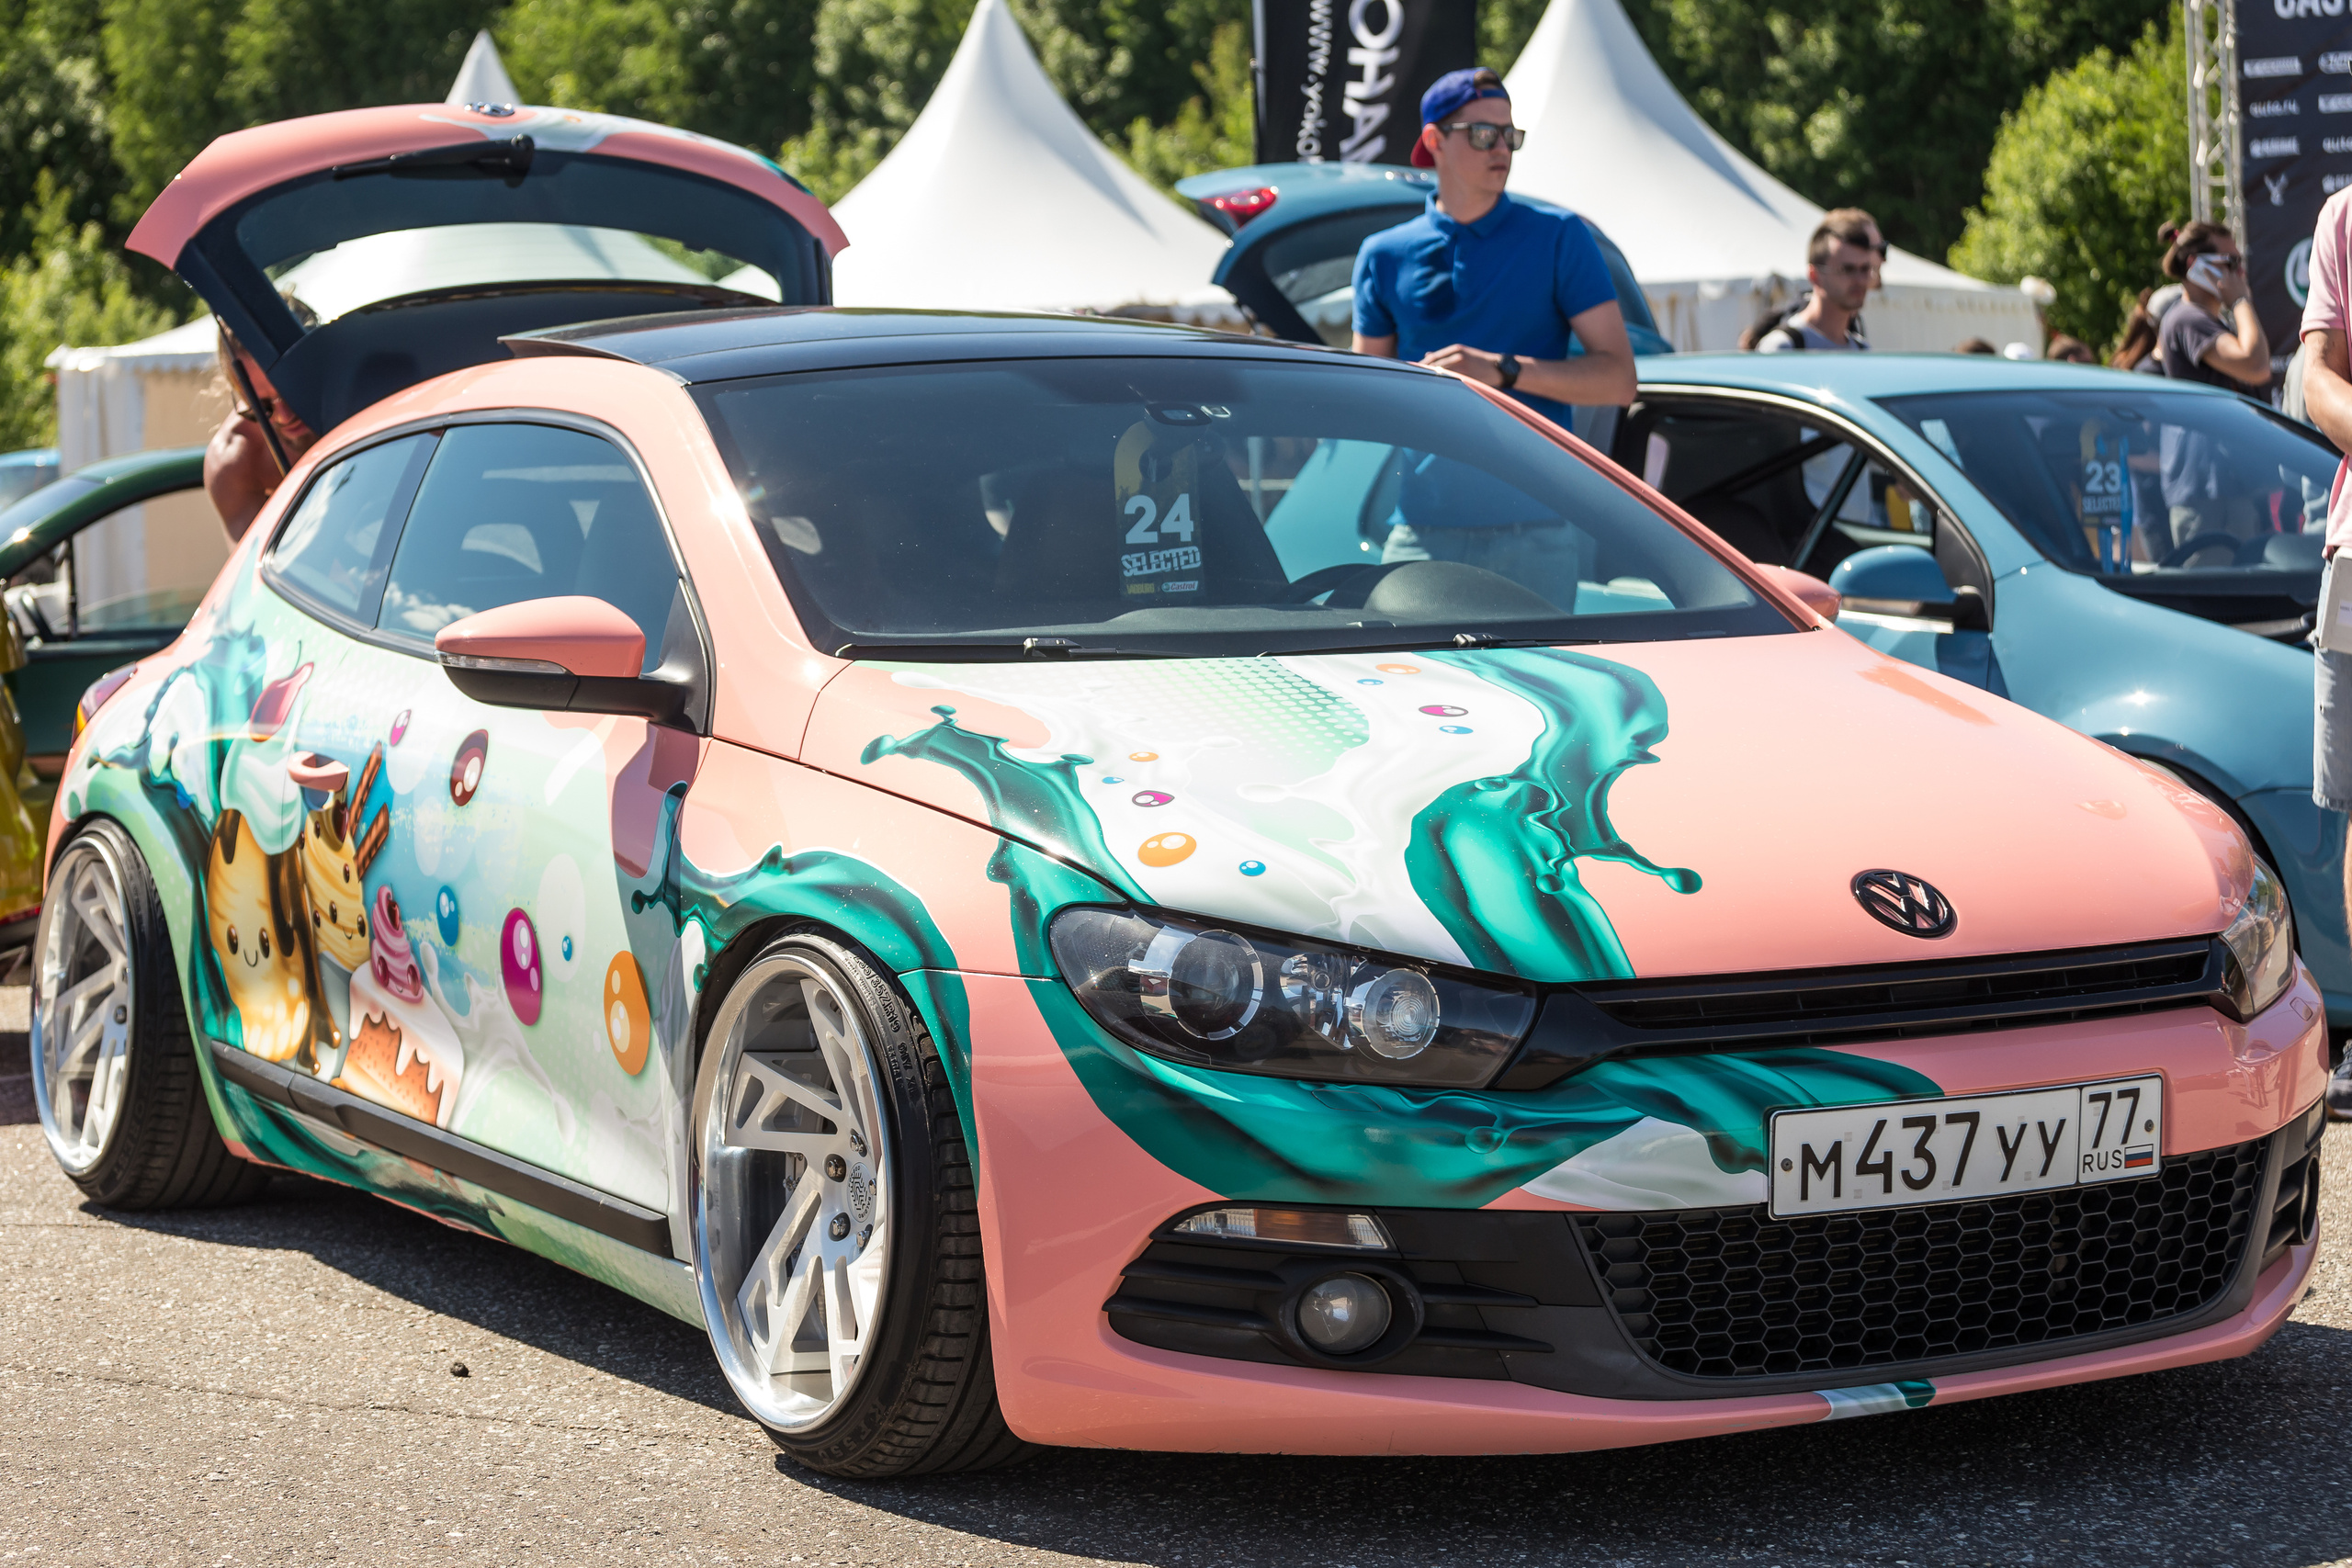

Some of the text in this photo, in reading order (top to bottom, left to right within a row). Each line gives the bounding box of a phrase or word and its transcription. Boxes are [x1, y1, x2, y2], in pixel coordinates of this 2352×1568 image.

[2085, 460, 2120, 493] 23
[1124, 493, 1194, 544] 24
[1121, 546, 1202, 577] SELECTED
[1170, 581, 1196, 591] Castrol
[2087, 1087, 2142, 1149] 77
[2082, 1148, 2123, 1174] RUS
